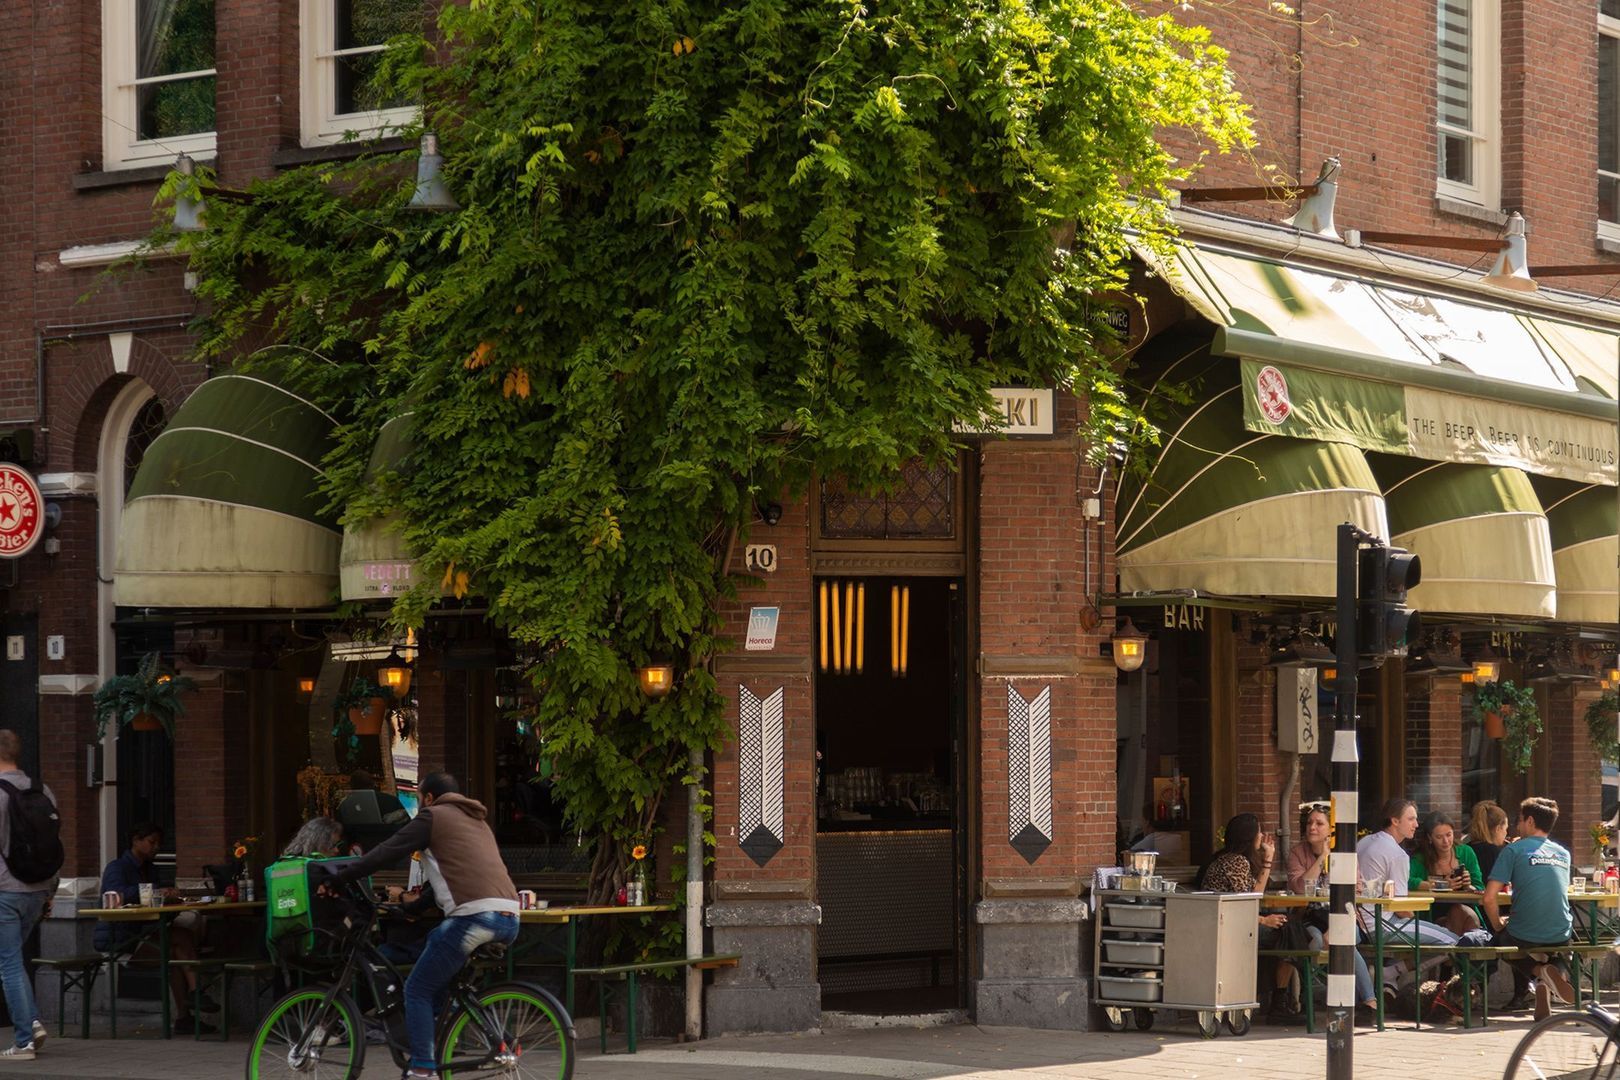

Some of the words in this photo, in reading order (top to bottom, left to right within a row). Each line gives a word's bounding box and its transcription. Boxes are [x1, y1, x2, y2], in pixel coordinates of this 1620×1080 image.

[1412, 417, 1436, 436] THE
[1547, 439, 1615, 466] CONTINUOUS
[747, 547, 774, 569] 10
[1164, 604, 1205, 632] BAR
[748, 637, 773, 646] Horeca
[278, 898, 298, 910] Eats
